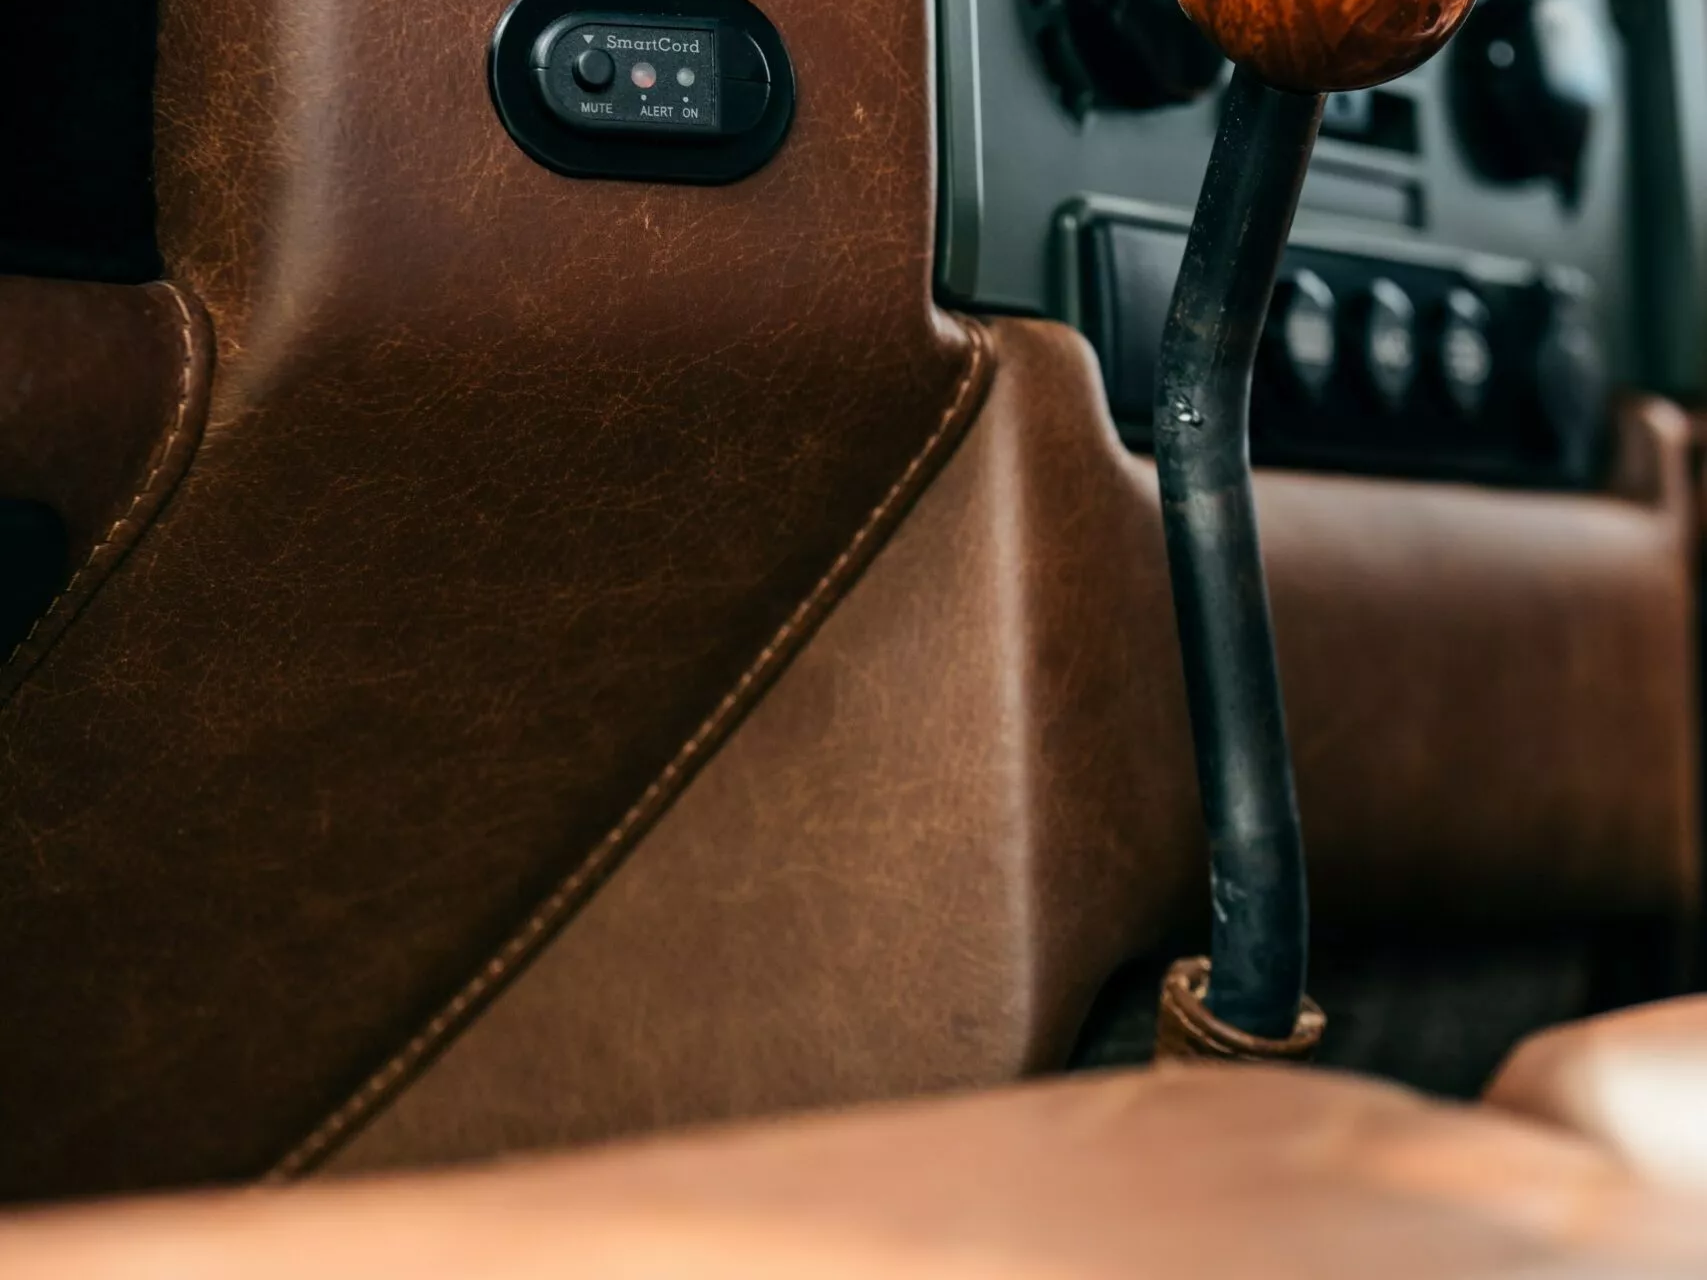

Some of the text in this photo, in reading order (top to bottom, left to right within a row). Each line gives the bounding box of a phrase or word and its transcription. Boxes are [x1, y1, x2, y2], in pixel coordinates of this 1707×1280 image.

[606, 34, 700, 54] SmartCord
[580, 102, 699, 119] MUTE ALERT ON
